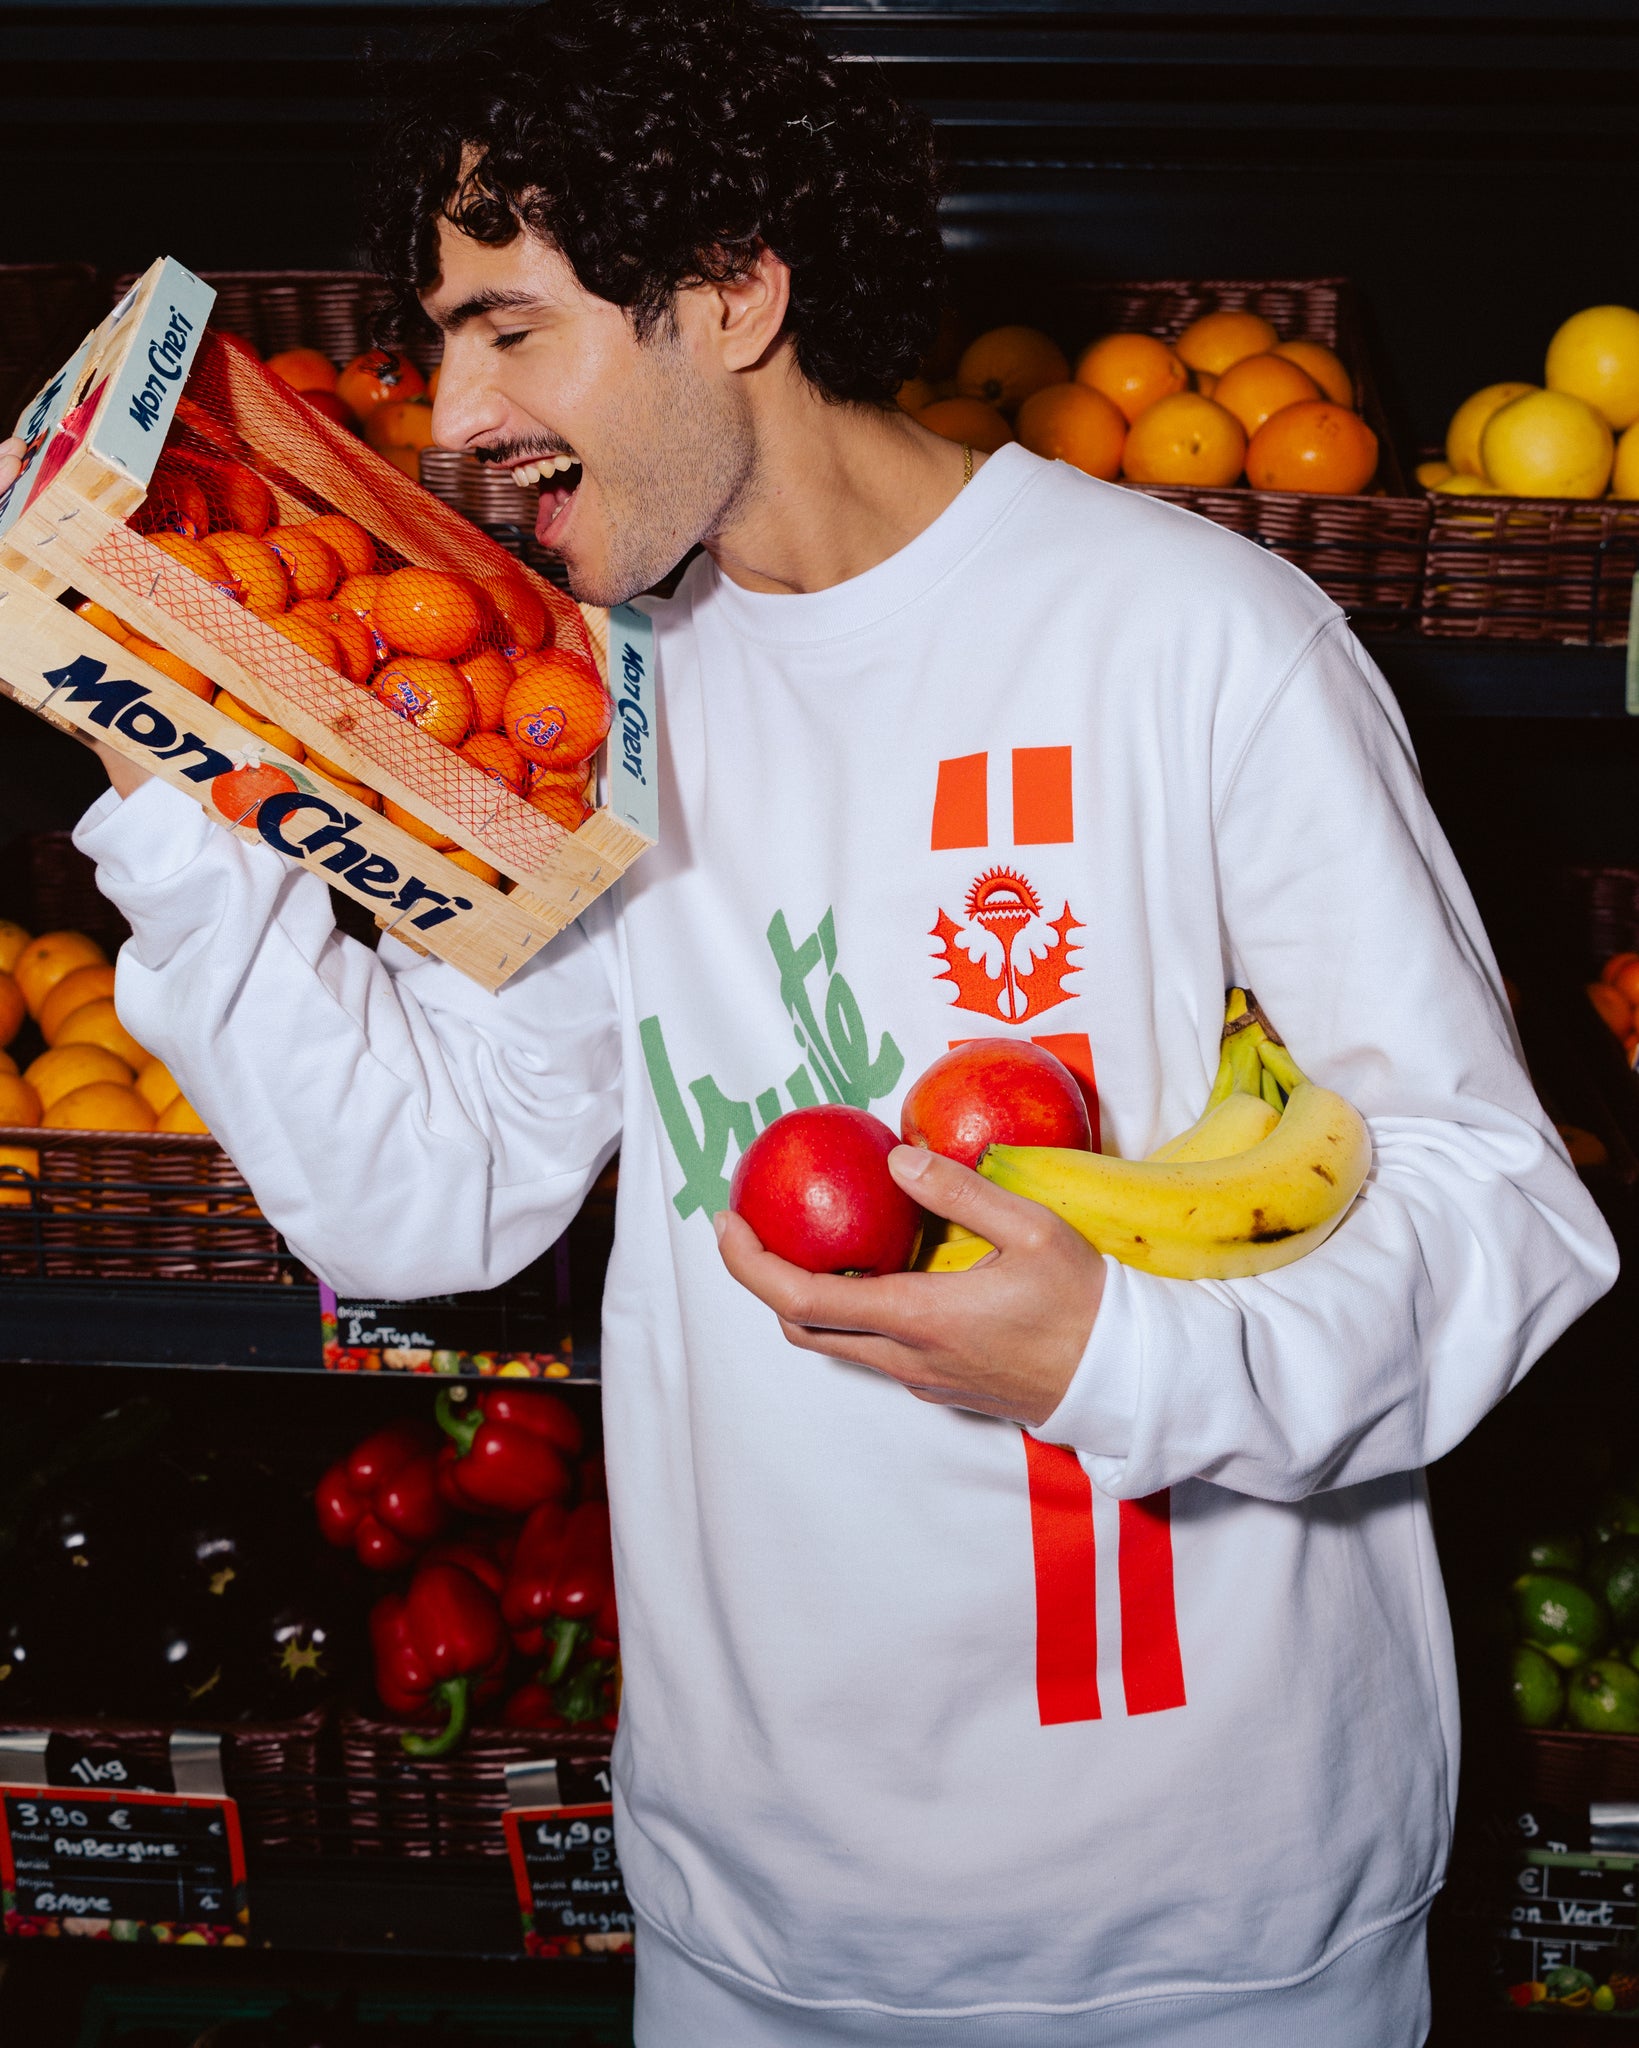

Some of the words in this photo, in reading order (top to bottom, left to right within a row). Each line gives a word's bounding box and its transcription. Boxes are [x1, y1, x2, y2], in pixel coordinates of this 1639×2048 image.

[129, 373, 167, 432] Mon
[148, 305, 194, 381] Cheri
[622, 642, 646, 701] Mon
[617, 698, 649, 786] Cheri
[42, 655, 235, 783] Mon
[256, 791, 473, 931] Cheri
[70, 1756, 128, 1785] 1kg
[16, 1802, 88, 1828] 3.90
[108, 1809, 133, 1831] €
